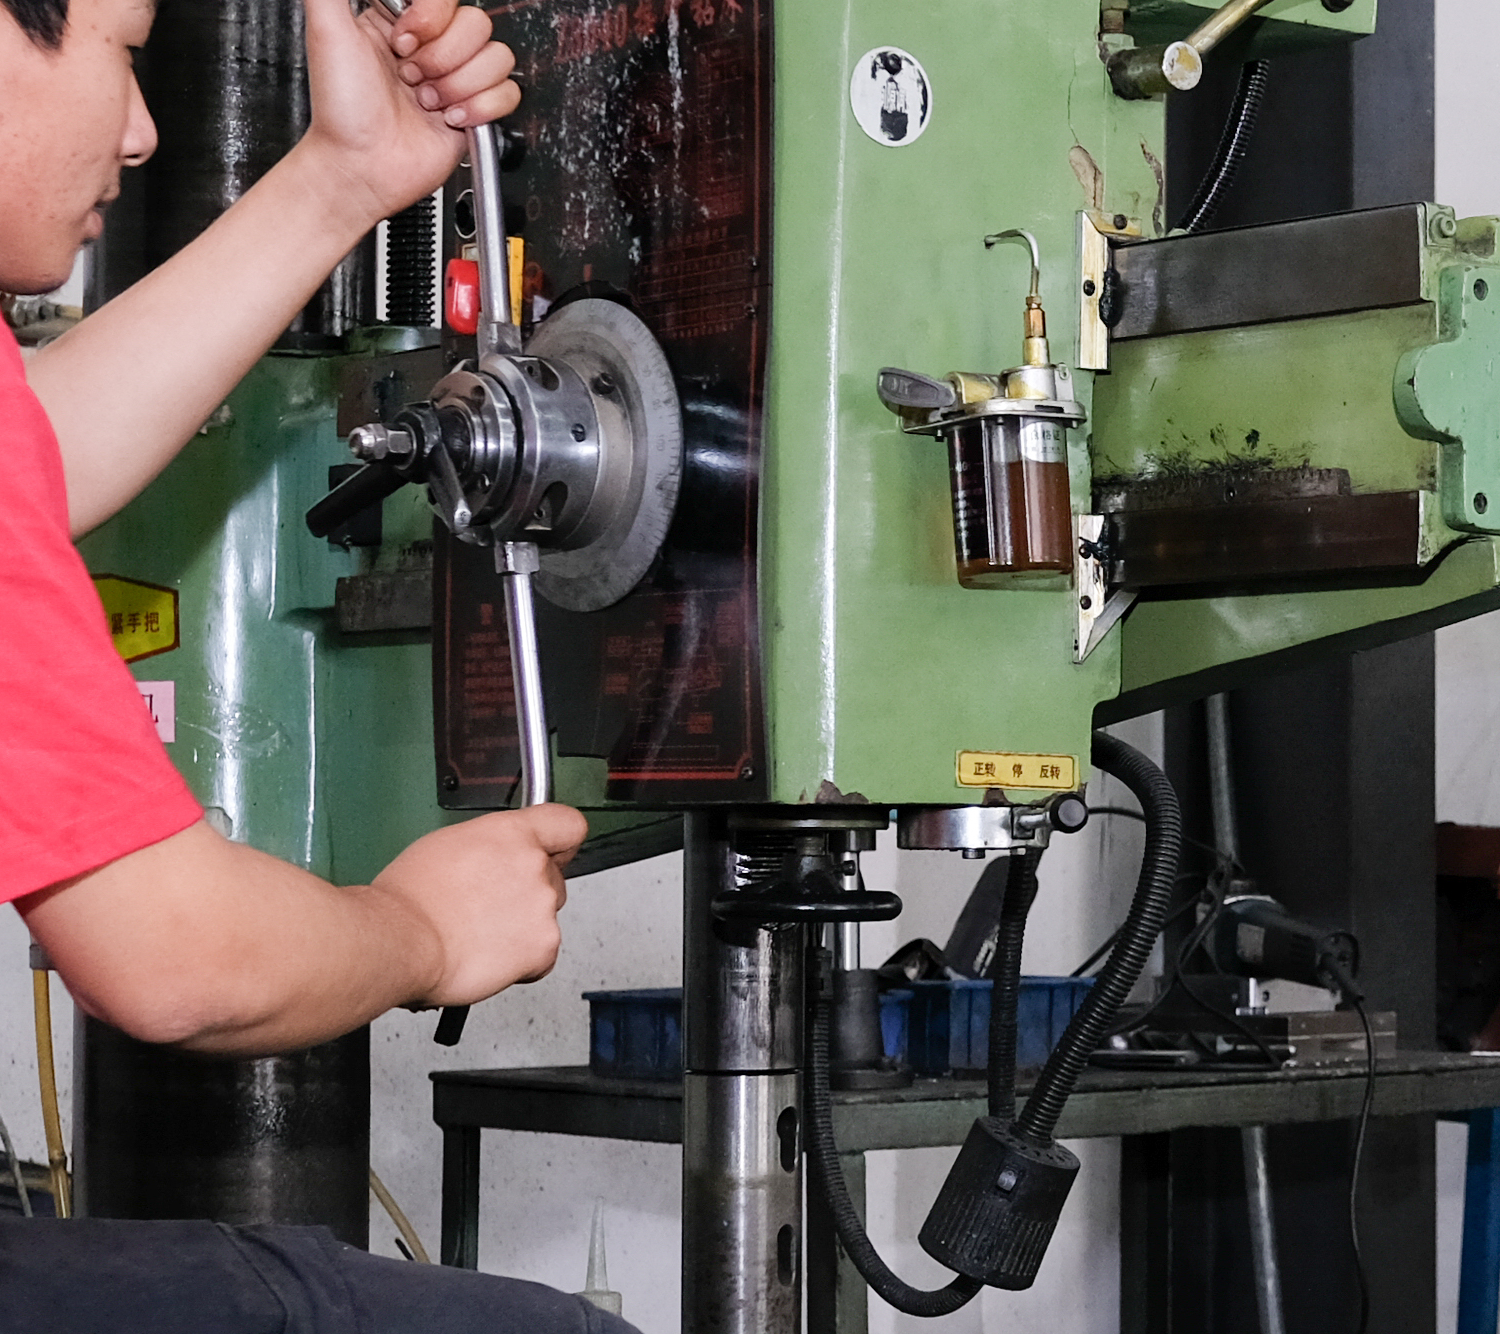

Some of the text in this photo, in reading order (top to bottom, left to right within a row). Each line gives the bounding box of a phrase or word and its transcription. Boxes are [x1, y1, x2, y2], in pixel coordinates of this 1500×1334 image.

[973, 762, 1061, 780] 正转 停 反转
